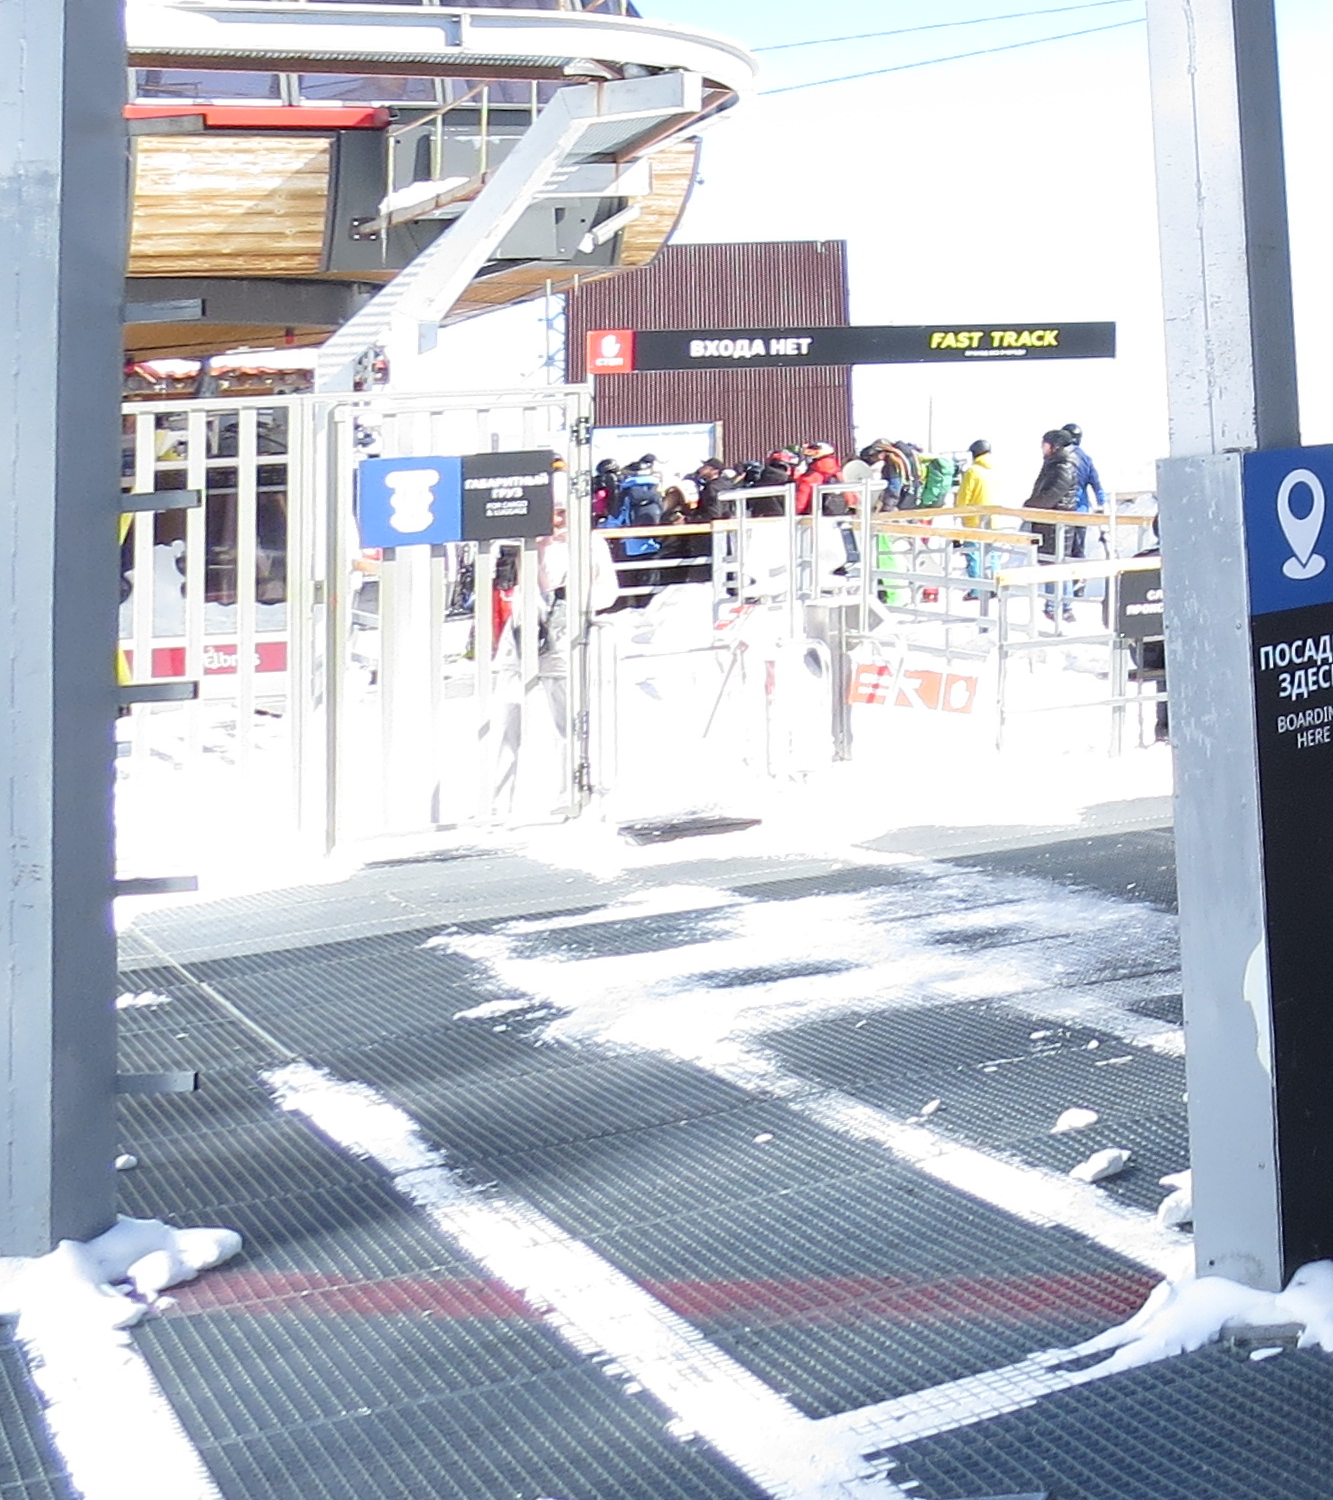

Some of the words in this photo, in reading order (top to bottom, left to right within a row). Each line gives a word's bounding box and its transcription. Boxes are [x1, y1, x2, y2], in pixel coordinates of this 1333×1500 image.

[689, 338, 764, 359] ВХОДА
[770, 337, 812, 356] НЕТ
[929, 332, 984, 349] FAST
[990, 330, 1059, 347] TRACK
[1296, 726, 1331, 749] HERE
